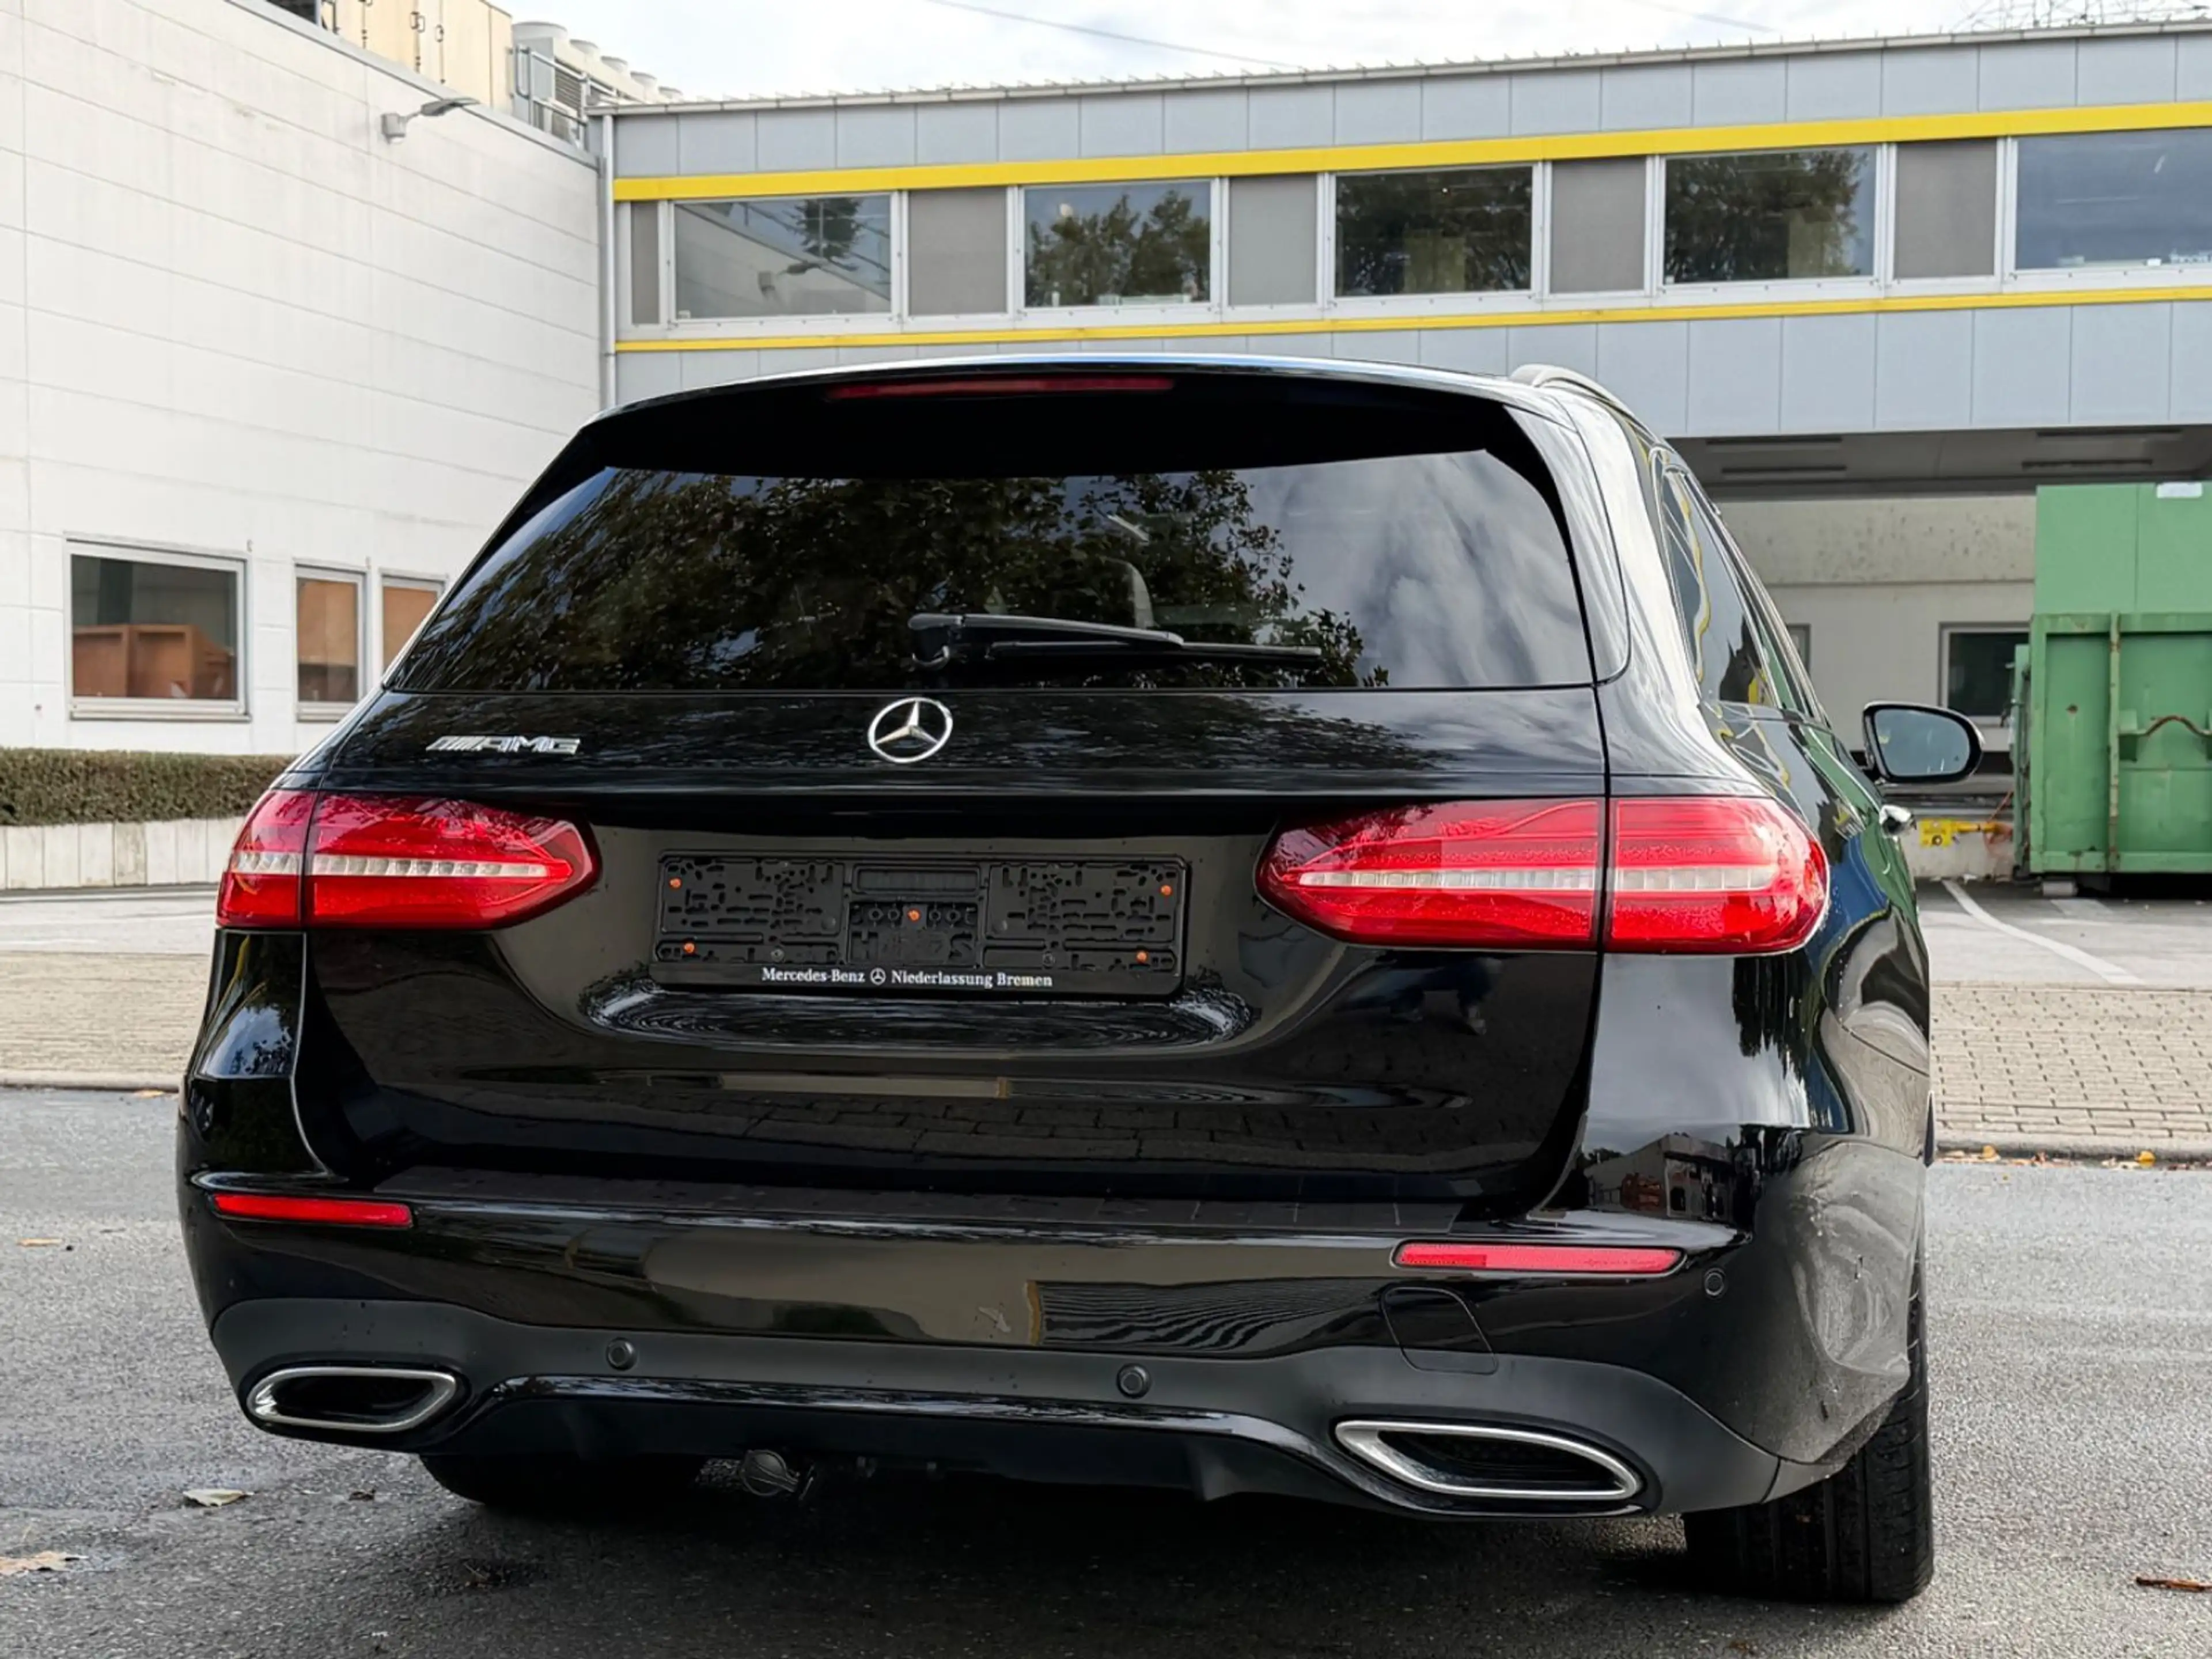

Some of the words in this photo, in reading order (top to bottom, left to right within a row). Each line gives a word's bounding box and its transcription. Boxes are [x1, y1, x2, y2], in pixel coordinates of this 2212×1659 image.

[465, 735, 581, 755] AMG
[762, 967, 865, 982] Mercedes-Benz
[891, 969, 993, 988] Niederlassung
[997, 972, 1053, 987] Bremen
